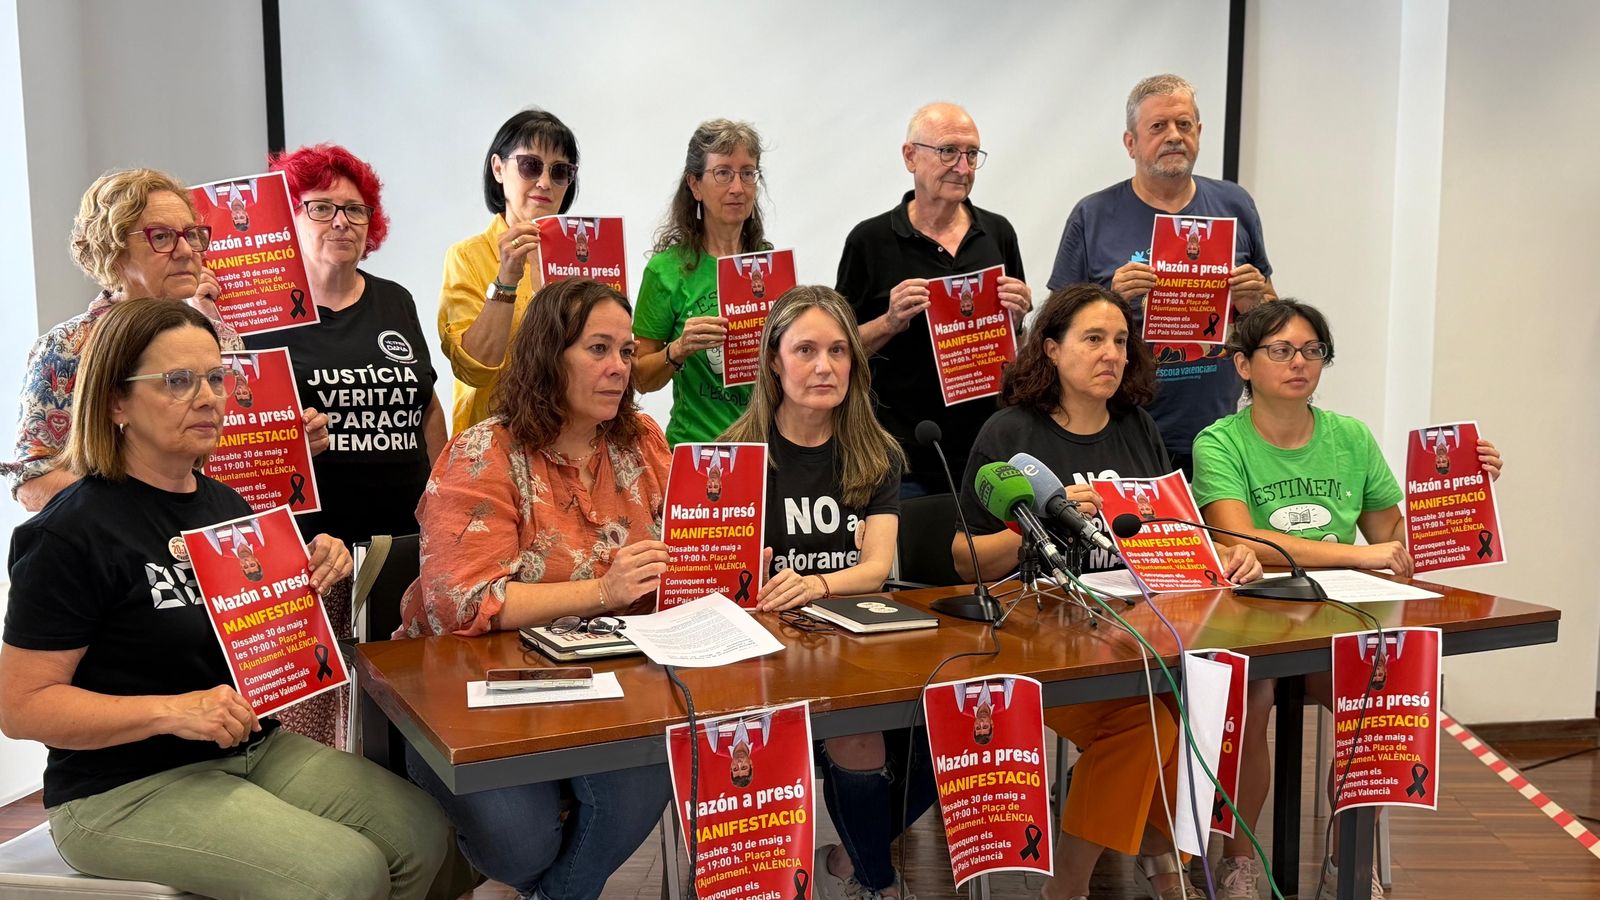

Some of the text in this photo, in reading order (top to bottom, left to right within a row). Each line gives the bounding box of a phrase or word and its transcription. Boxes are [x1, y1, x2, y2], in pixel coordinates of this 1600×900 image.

[245, 236, 252, 246] a
[255, 227, 291, 248] presó
[206, 245, 295, 270] MANIFESTACIÓ
[548, 263, 580, 276] Mazón
[591, 264, 620, 279] presó
[1157, 260, 1228, 276] Mazón a presó
[1155, 278, 1226, 288] MANIFESTACIÓ
[725, 301, 757, 316] Mazón
[760, 302, 766, 311] a
[728, 318, 765, 330] MANIFE
[935, 310, 1004, 335] Mazón a presó
[938, 325, 1007, 350] MANIFESTACIÓ
[307, 364, 418, 386] JUSTÍCIA
[317, 387, 418, 407] VERITAT
[223, 406, 295, 426] zón a presó
[328, 405, 423, 429] PARACIÓ
[209, 453, 241, 462] Dissabte
[260, 465, 296, 476] VALÈNCIA
[1408, 471, 1483, 494] Mazón a presó
[1409, 488, 1486, 511] MANIFESTACIÓ
[671, 502, 755, 522] Mazón a presó
[784, 496, 840, 534] NO
[1411, 513, 1436, 523] Dissabte
[670, 523, 754, 539] MANIFESTACIÓ
[1153, 524, 1161, 532] a
[1451, 523, 1484, 533] VALÈNCIA
[1121, 534, 1201, 548] MANIFESTACIÓ
[1414, 541, 1445, 551] Convoquen
[1415, 546, 1470, 559] moviments socials
[1438, 554, 1465, 563] Valencià
[714, 562, 746, 570] VALÈNCIA
[211, 569, 309, 614] Mazón a presó
[665, 586, 704, 595] moviments
[666, 578, 704, 586] Convoquen
[223, 591, 314, 635] MANIFESTACIÓ
[231, 632, 265, 649] Dissabte
[265, 628, 275, 638] 30
[276, 625, 286, 634] de
[286, 620, 304, 631] maig
[235, 652, 248, 660] les
[249, 642, 270, 655] 19:00
[272, 639, 278, 648] h.
[279, 634, 297, 645] Plaça
[239, 636, 318, 671] l'Ajuntament, VALÈNCIA
[244, 662, 295, 686] Convoquen els
[248, 668, 310, 698] moviments socials
[252, 680, 307, 708] del País Valencià
[1337, 691, 1430, 713] Mazón a presó
[1337, 713, 1429, 734] MANIFESTACIÓ
[937, 748, 1040, 774] Mazón a presó
[1378, 751, 1421, 762] VALÈNCIA
[742, 794, 752, 808] a
[756, 778, 804, 809] presó
[940, 771, 1040, 798] MANIFESTACIÓ
[971, 795, 980, 803] 30
[995, 792, 1018, 800] maig
[952, 809, 970, 820] 19:00
[982, 804, 1005, 812] Plaça
[988, 812, 1034, 823] VALÈNCIA
[697, 805, 806, 844] ANIFESTACIÓ
[697, 846, 729, 862] issabte
[731, 842, 742, 852] 30
[745, 839, 756, 849] de
[759, 835, 783, 846] maig
[981, 840, 1012, 850] socials
[708, 847, 786, 871] 19:00 h. Plaça de
[752, 858, 802, 872] VALÈNCIA
